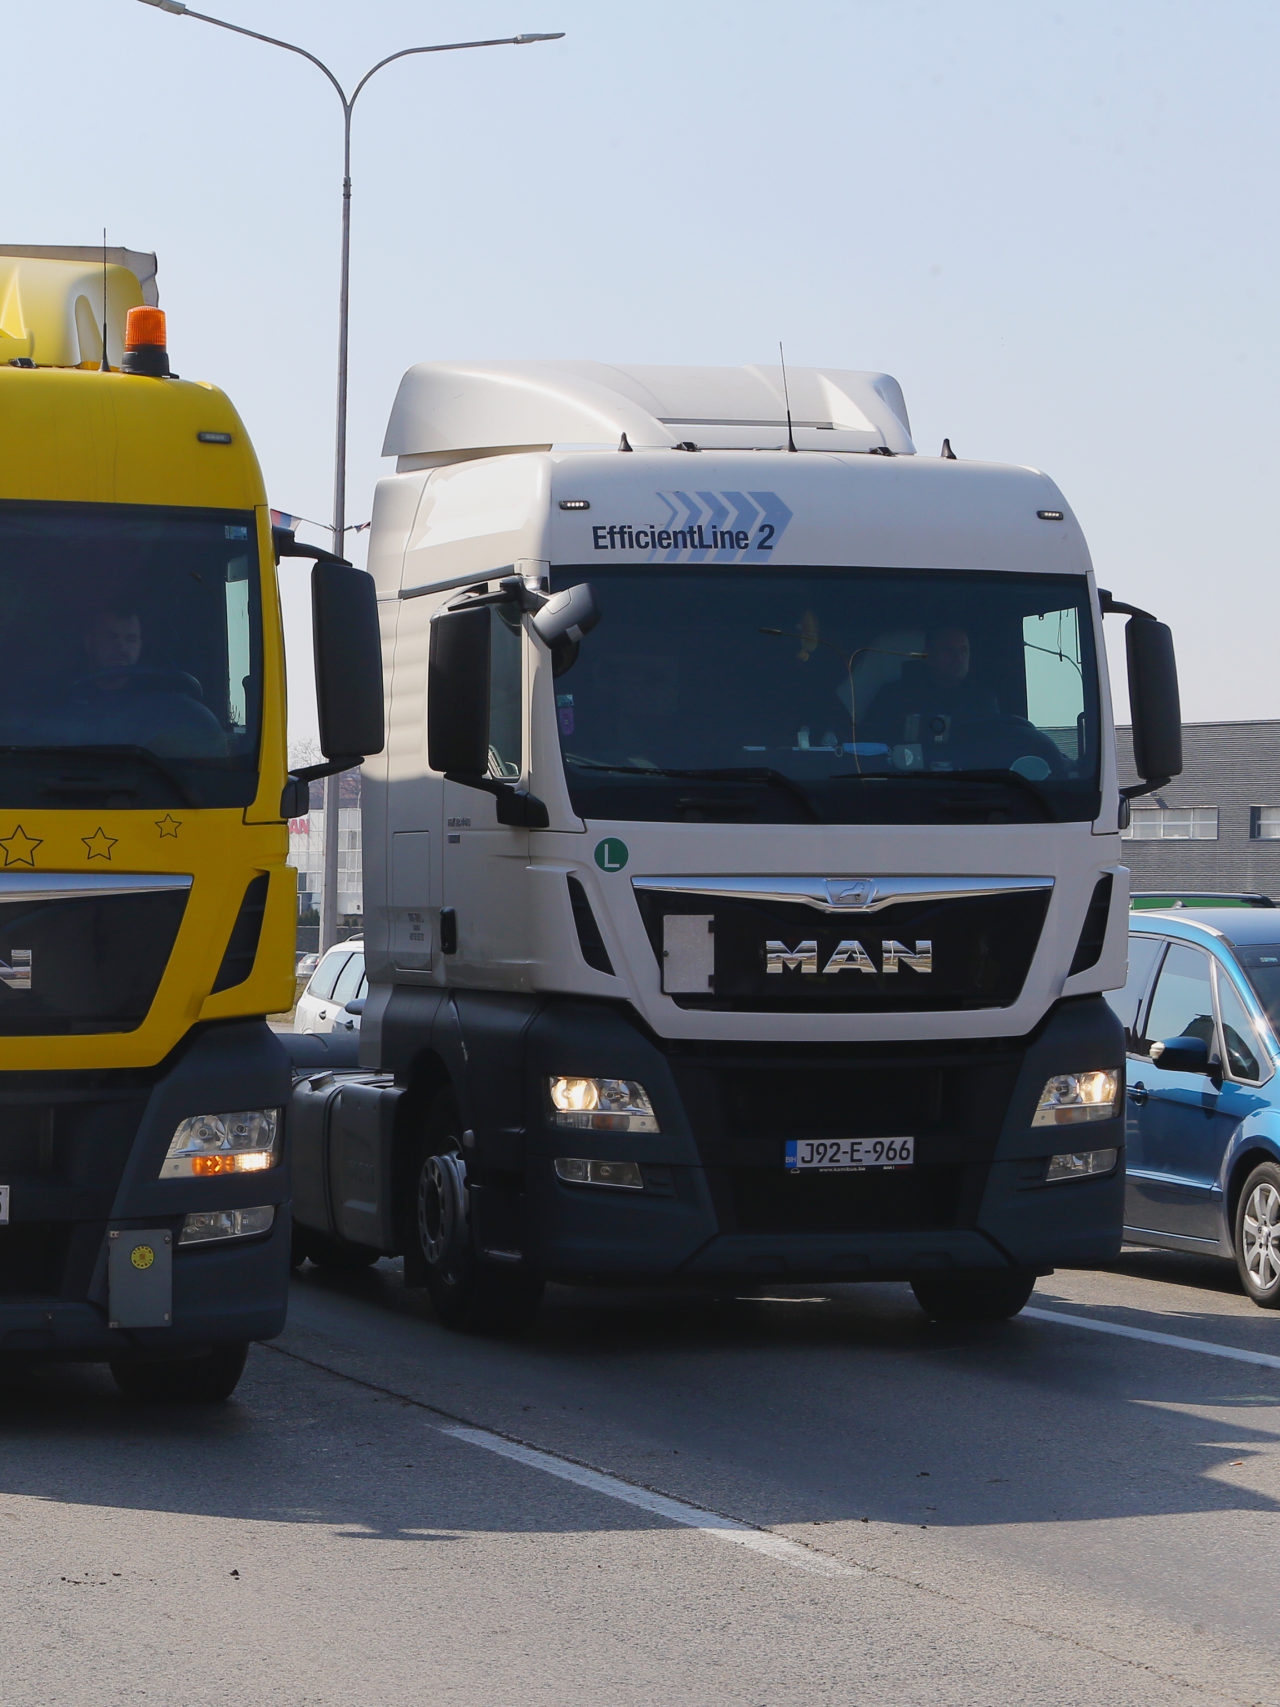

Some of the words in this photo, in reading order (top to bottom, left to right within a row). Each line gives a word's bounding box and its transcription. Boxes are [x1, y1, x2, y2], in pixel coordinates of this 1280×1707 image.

[592, 524, 749, 550] EfficientLine
[757, 524, 775, 550] 2
[289, 818, 310, 835] AN
[604, 843, 620, 868] L
[765, 940, 932, 974] MAN
[800, 1140, 911, 1164] J92-E-966
